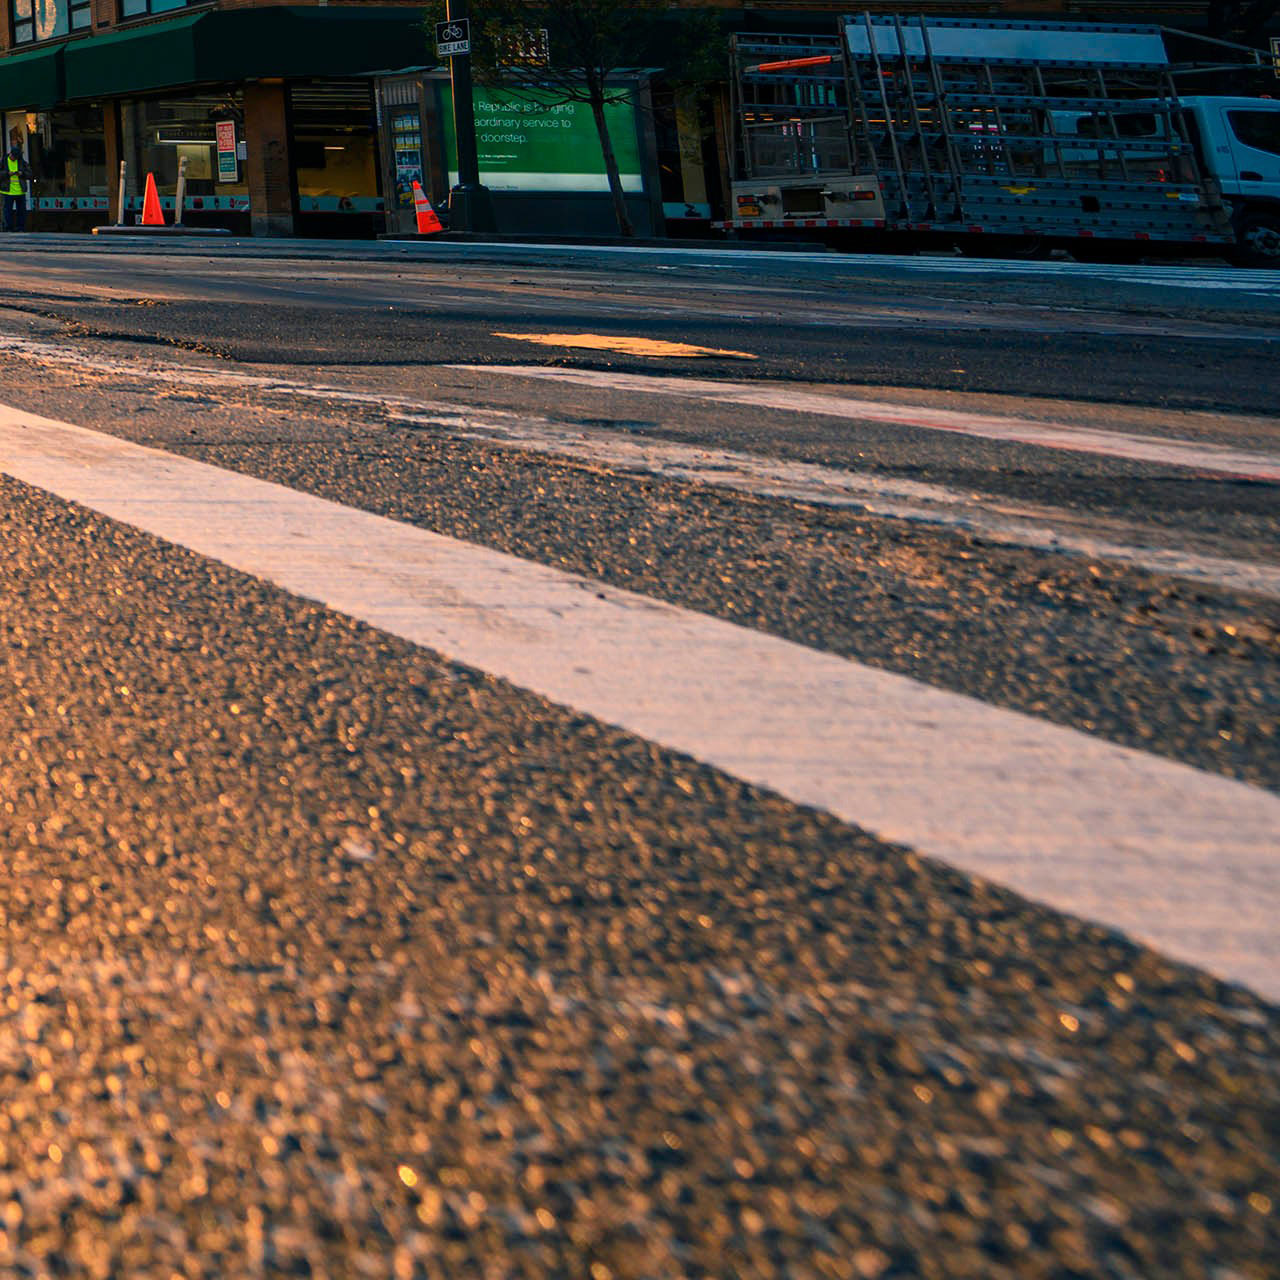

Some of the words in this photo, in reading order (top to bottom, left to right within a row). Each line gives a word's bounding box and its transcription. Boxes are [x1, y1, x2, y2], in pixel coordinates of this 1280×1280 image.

[439, 43, 453, 53] BIKE
[454, 40, 469, 51] LANE
[522, 118, 559, 128] service
[561, 118, 572, 128] to
[480, 132, 528, 145] doorstep.
